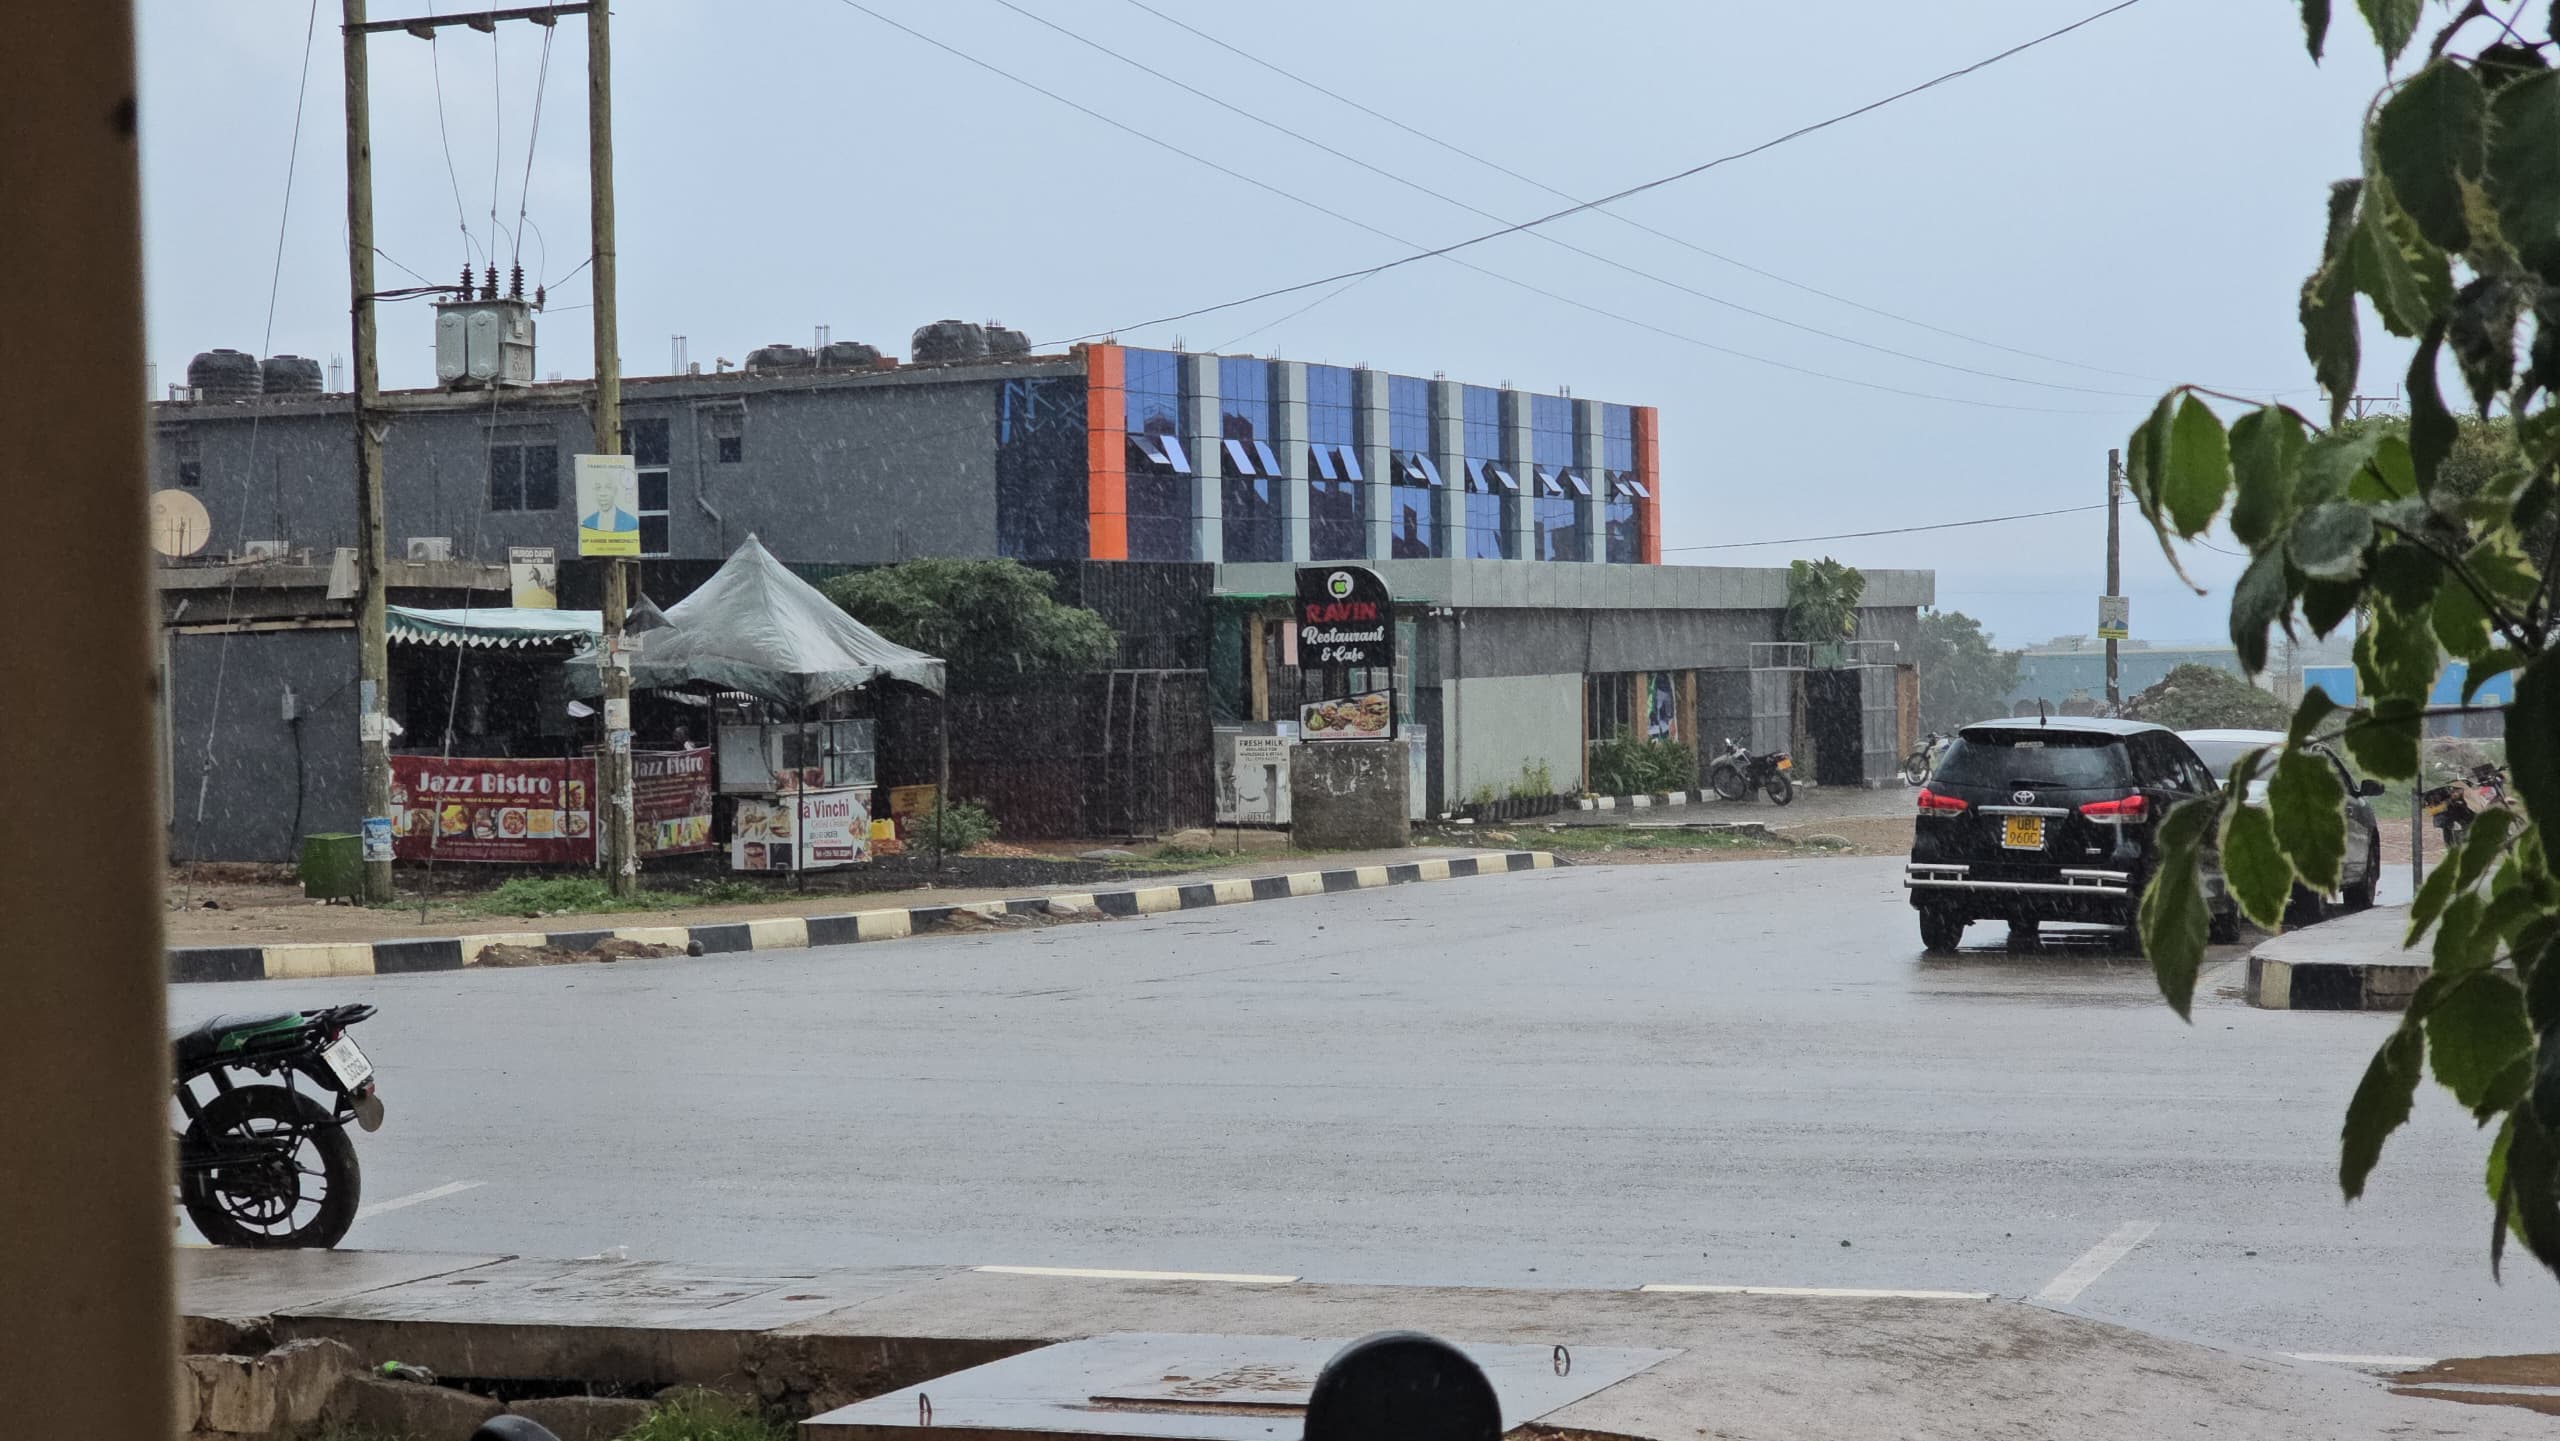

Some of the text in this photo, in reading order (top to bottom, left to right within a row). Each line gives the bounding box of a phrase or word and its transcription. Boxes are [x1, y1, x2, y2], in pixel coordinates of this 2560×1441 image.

[1305, 602, 1377, 623] RAVIN
[1302, 624, 1385, 646] Restaurant
[1321, 646, 1365, 663] & Cafe
[1239, 739, 1284, 747] FRESH MILK
[634, 757, 703, 777] Jazz Bistro
[416, 772, 551, 793] Jazz Bistro
[813, 798, 850, 819] Vinchi
[2017, 818, 2038, 831] UBL
